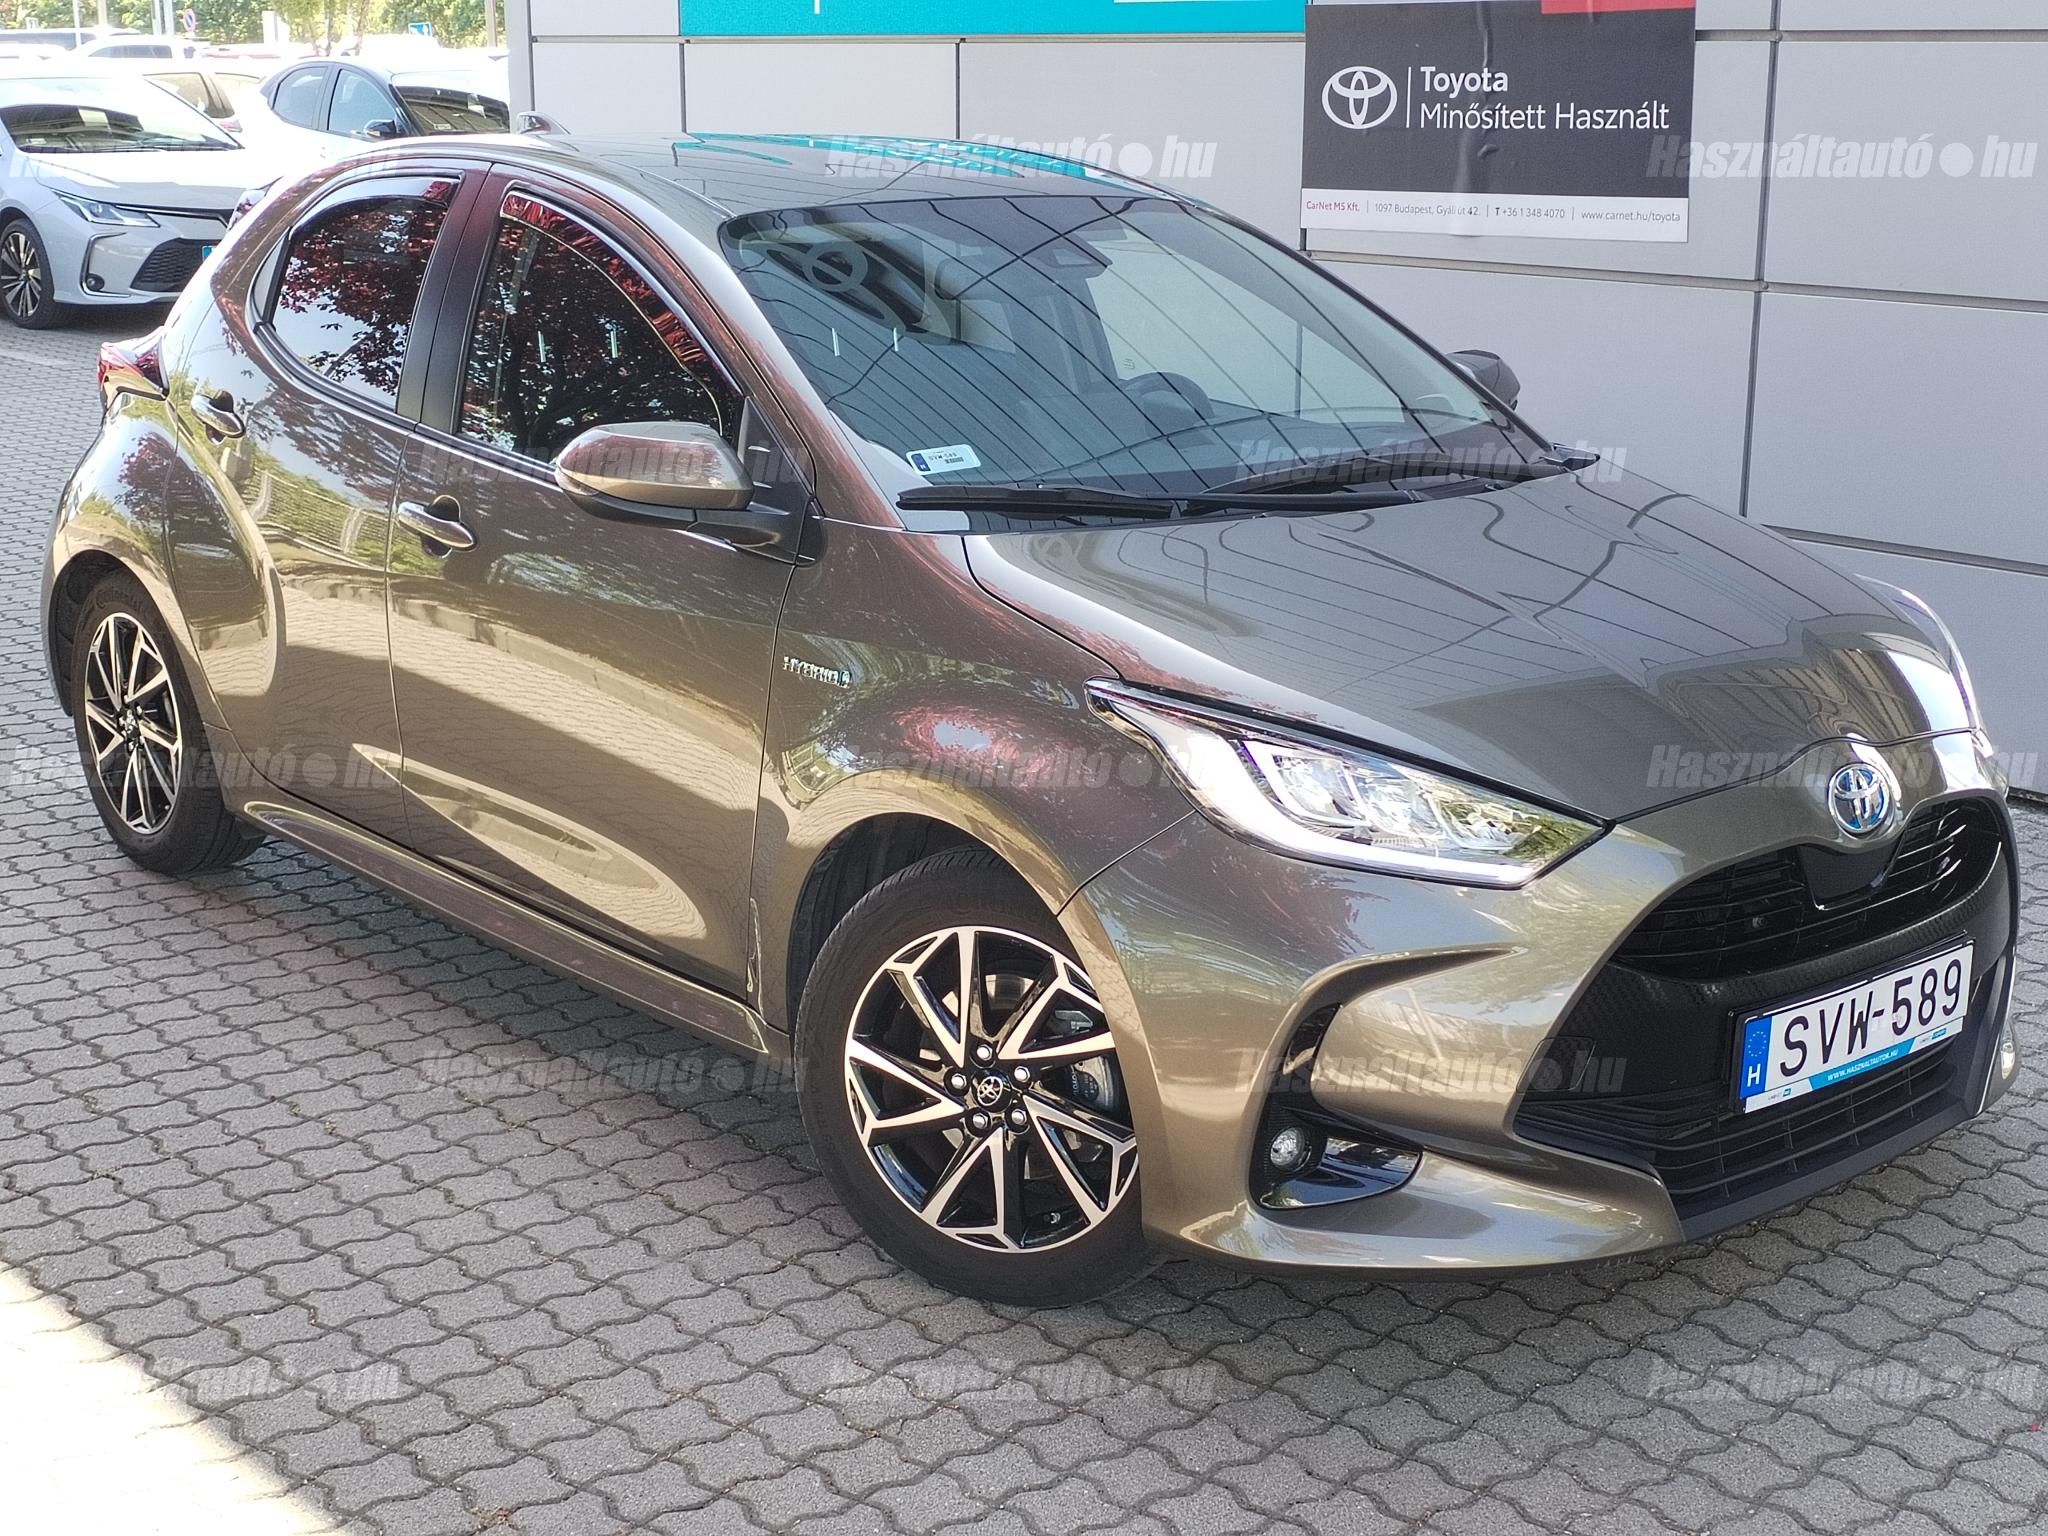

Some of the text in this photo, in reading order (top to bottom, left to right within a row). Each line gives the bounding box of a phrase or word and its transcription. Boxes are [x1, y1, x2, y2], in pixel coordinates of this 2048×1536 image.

[1420, 66, 1508, 98] Toyota
[1420, 100, 1669, 129] Minősített Használt
[1306, 201, 1333, 211] CarNet
[1347, 202, 1361, 212] Kft.
[1375, 203, 1392, 213] 1097
[1394, 203, 1434, 216] Budapest,
[1495, 207, 1500, 216] T
[1502, 207, 1518, 217] +36
[1526, 208, 1542, 218] 348
[1544, 208, 1566, 219] 4070
[1580, 211, 1681, 223] www.carnet.hu/toyota
[1780, 958, 1962, 1077] SVW-589
[1746, 1063, 1761, 1087] H
